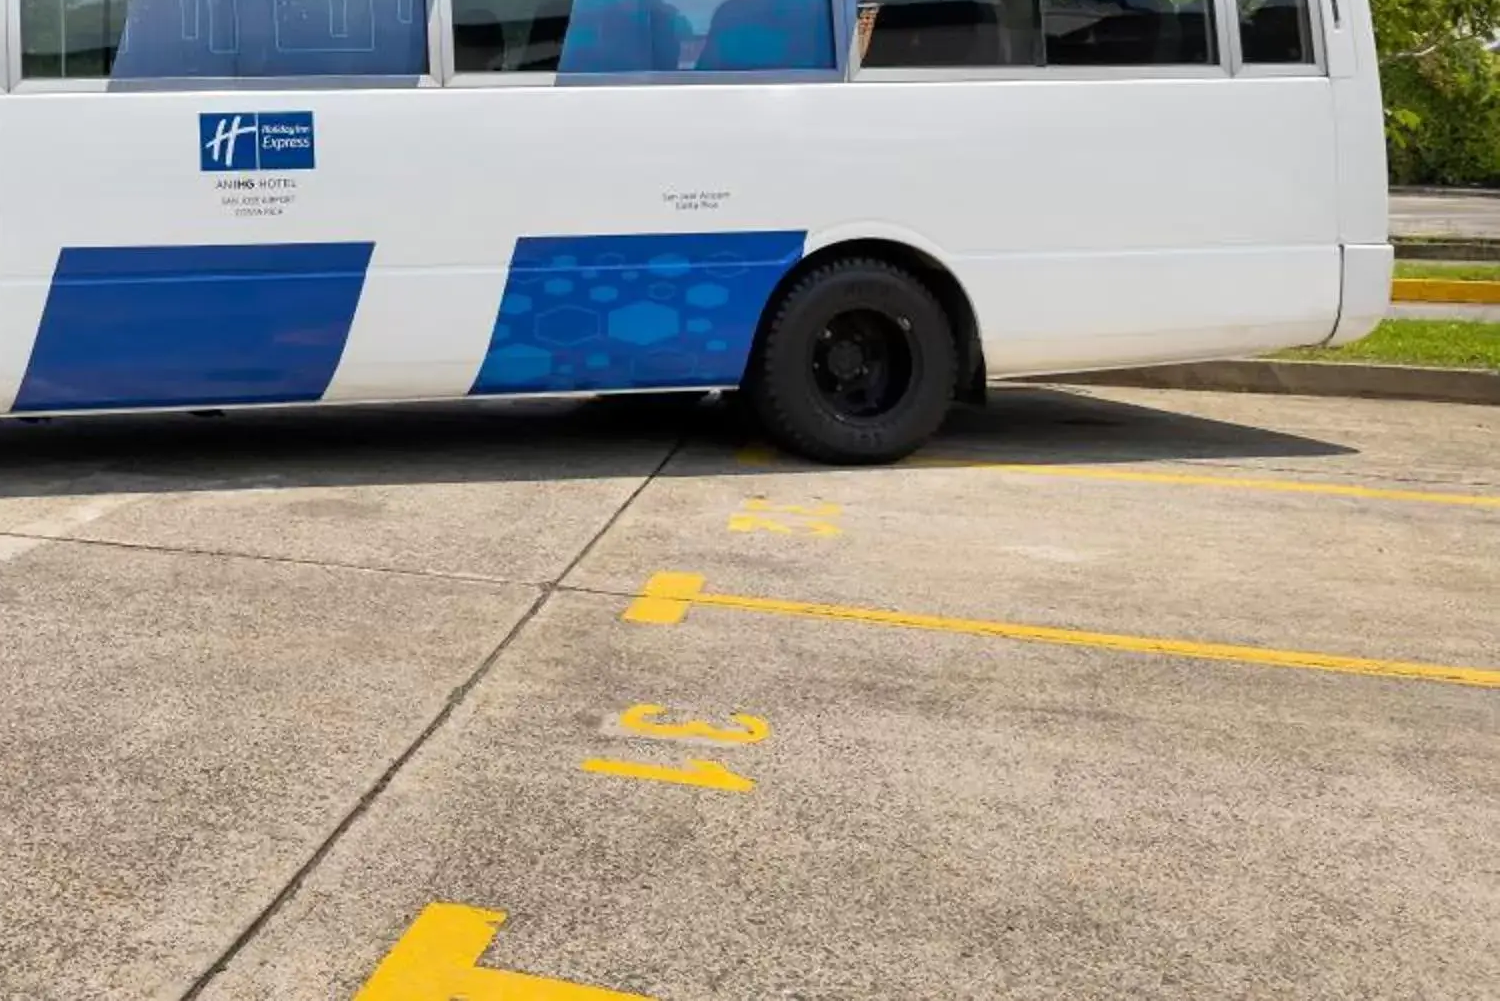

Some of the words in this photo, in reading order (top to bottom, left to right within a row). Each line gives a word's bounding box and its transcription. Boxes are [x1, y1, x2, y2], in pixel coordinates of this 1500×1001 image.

[262, 135, 309, 151] Express
[259, 178, 296, 188] HOTEL
[580, 702, 771, 791] 31
